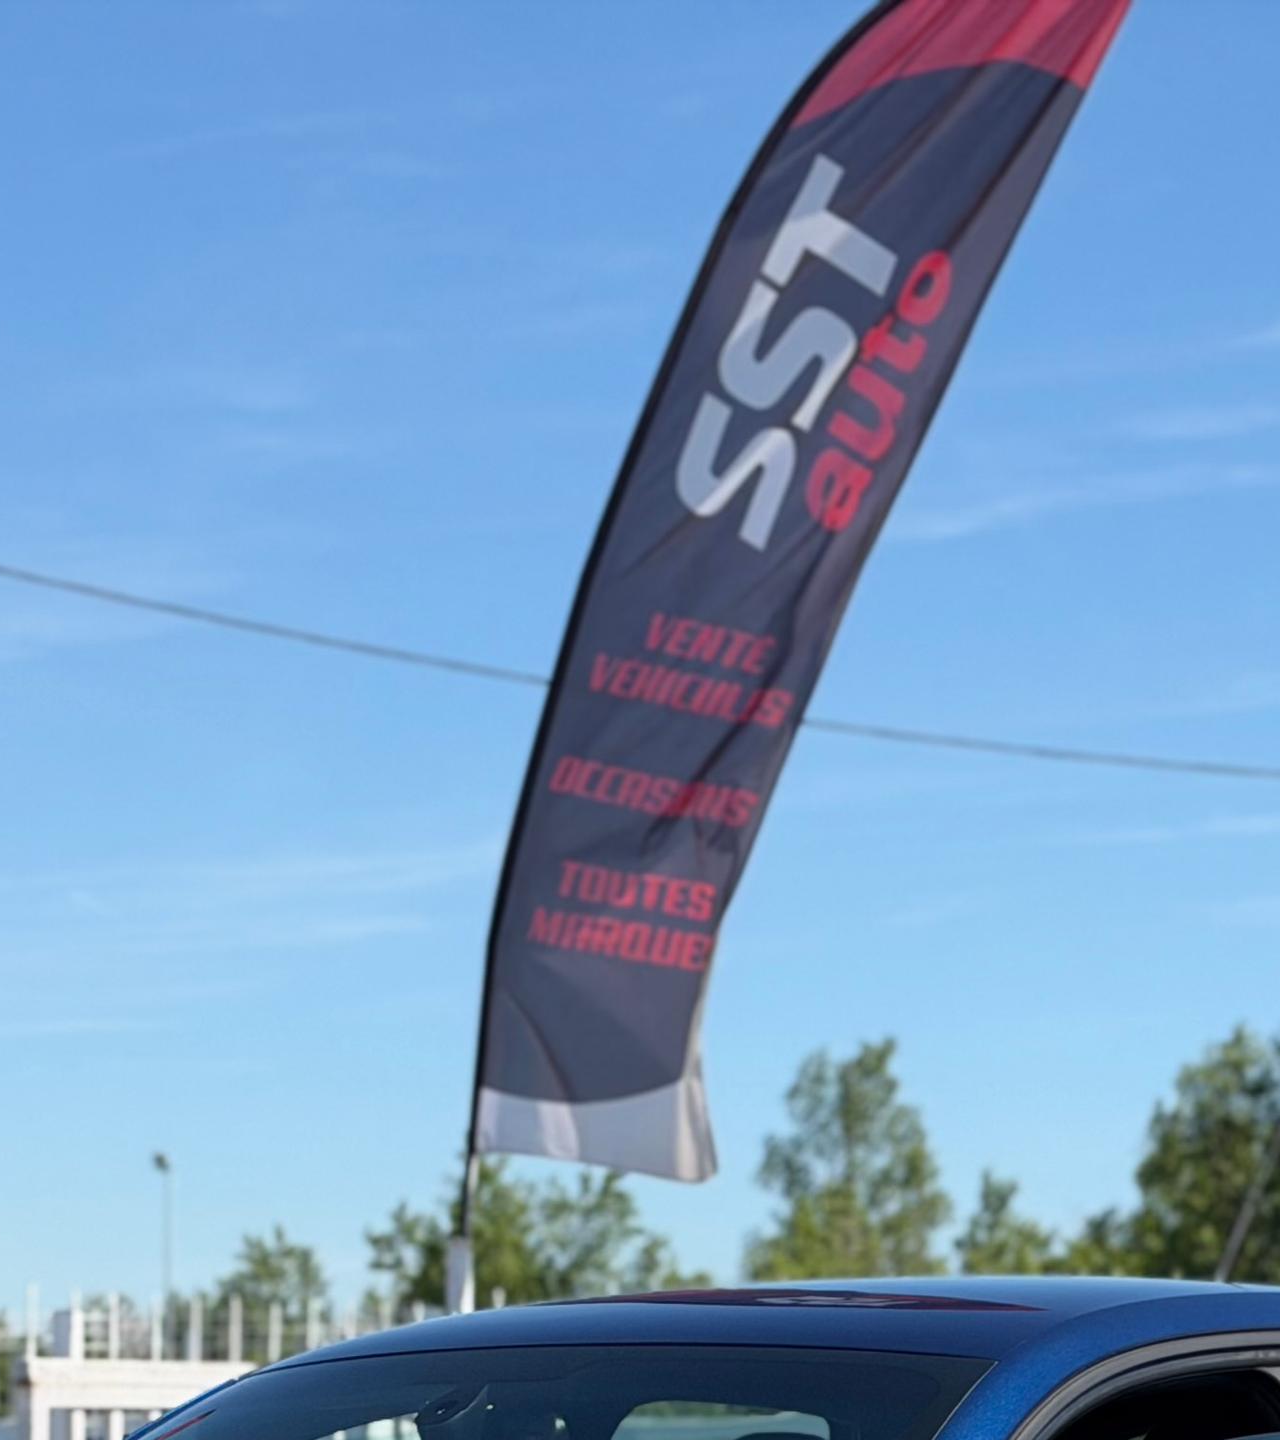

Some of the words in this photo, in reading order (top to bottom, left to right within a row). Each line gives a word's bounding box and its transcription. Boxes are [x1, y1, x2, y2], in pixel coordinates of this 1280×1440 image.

[675, 153, 898, 553] SST
[803, 250, 953, 533] auto
[646, 612, 776, 675] VENTE
[558, 858, 718, 923] TOUTES
